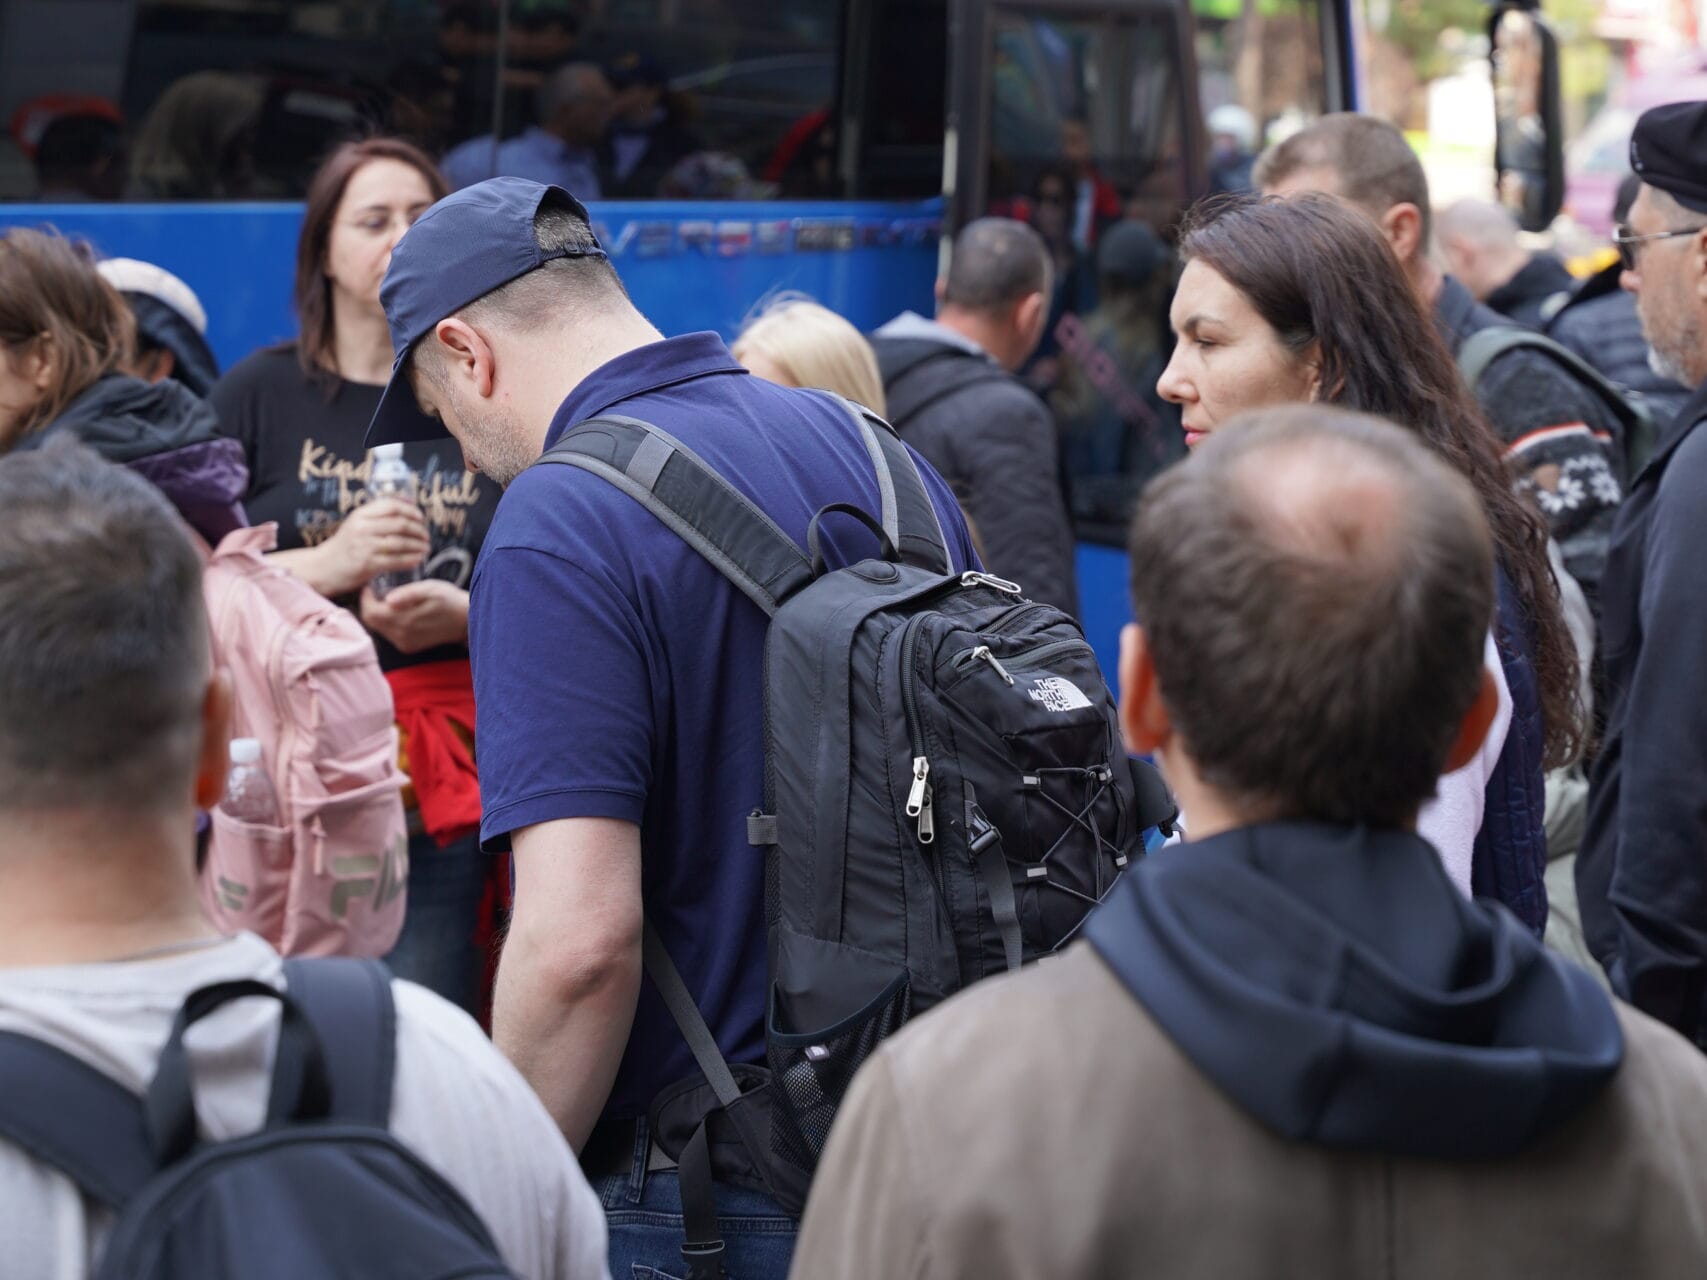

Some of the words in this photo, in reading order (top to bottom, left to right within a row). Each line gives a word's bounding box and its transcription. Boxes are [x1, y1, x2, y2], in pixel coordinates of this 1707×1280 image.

[1034, 677, 1059, 690] THE
[1027, 688, 1064, 701] NORTH
[1042, 699, 1071, 712] FACE
